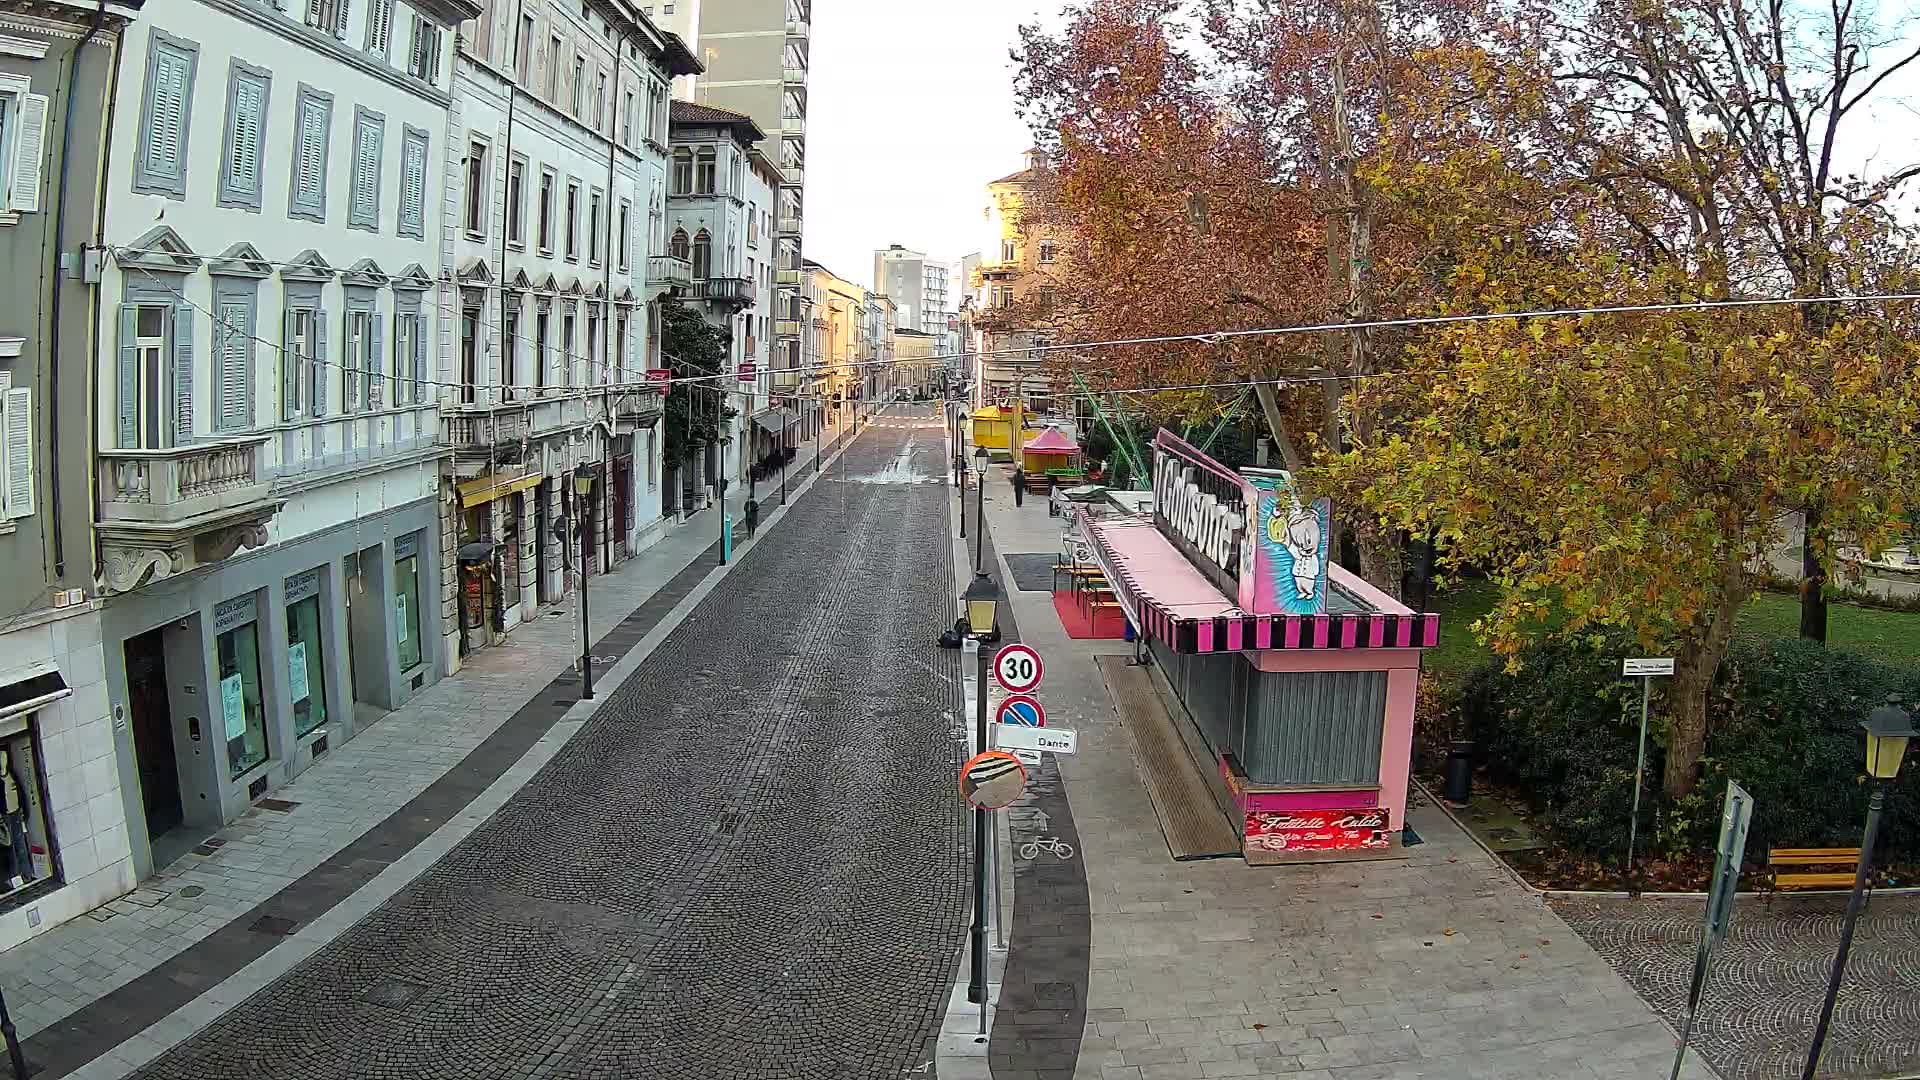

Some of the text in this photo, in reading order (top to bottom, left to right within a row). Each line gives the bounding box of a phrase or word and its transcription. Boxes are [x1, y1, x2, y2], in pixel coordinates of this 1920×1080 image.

[1163, 458, 1233, 570] Golosone
[1005, 657, 1033, 680] 30
[1038, 737, 1070, 749] Dante
